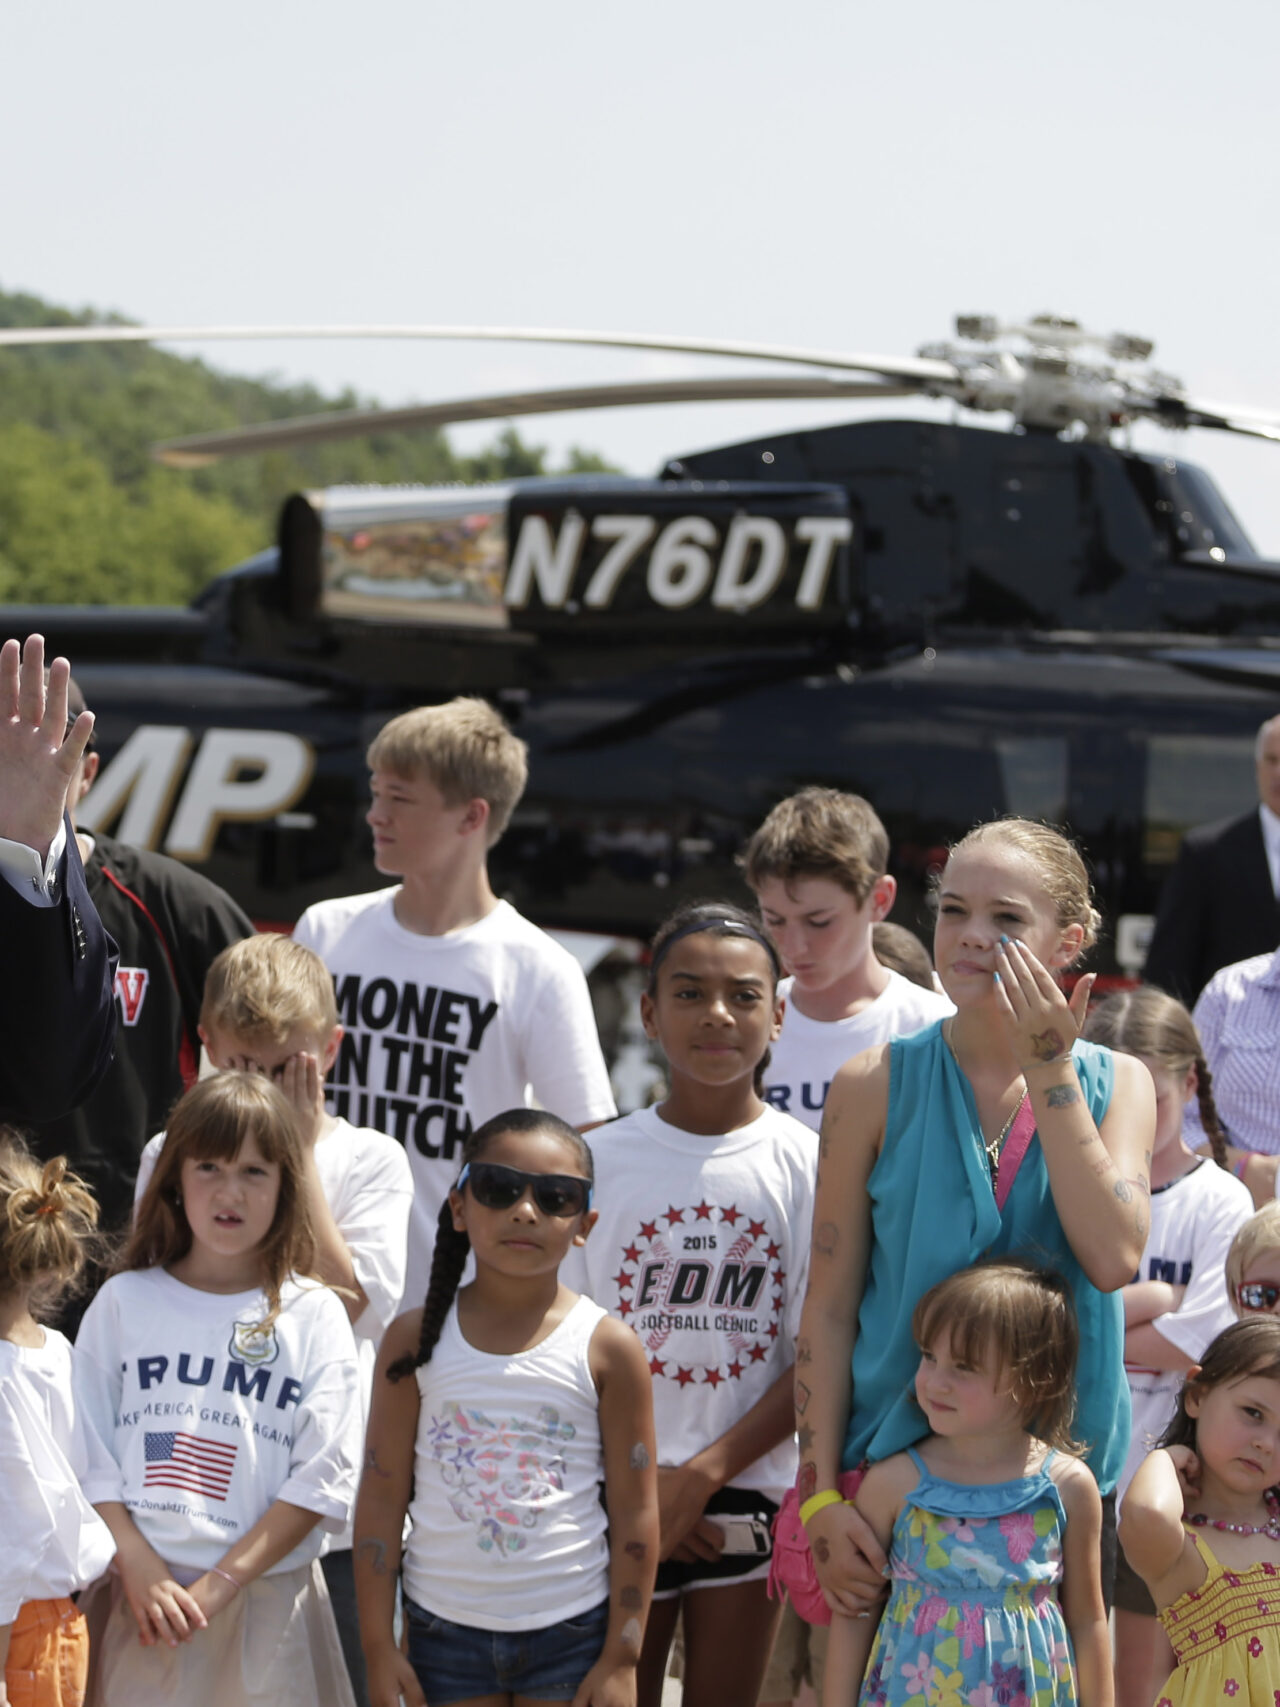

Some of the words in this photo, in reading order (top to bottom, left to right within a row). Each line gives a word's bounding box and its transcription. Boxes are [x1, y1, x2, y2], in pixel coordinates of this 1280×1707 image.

[505, 514, 853, 609] N76DT
[332, 975, 499, 1051] MONEY
[382, 1037, 470, 1106] THE
[324, 1089, 473, 1160] UTCH
[683, 1235, 718, 1251] 2015
[634, 1258, 768, 1310] EDM
[640, 1314, 710, 1332] SOFTBALL
[714, 1315, 759, 1334] CLINIC
[121, 1353, 303, 1411] RUMP
[200, 1408, 248, 1429] GREAT
